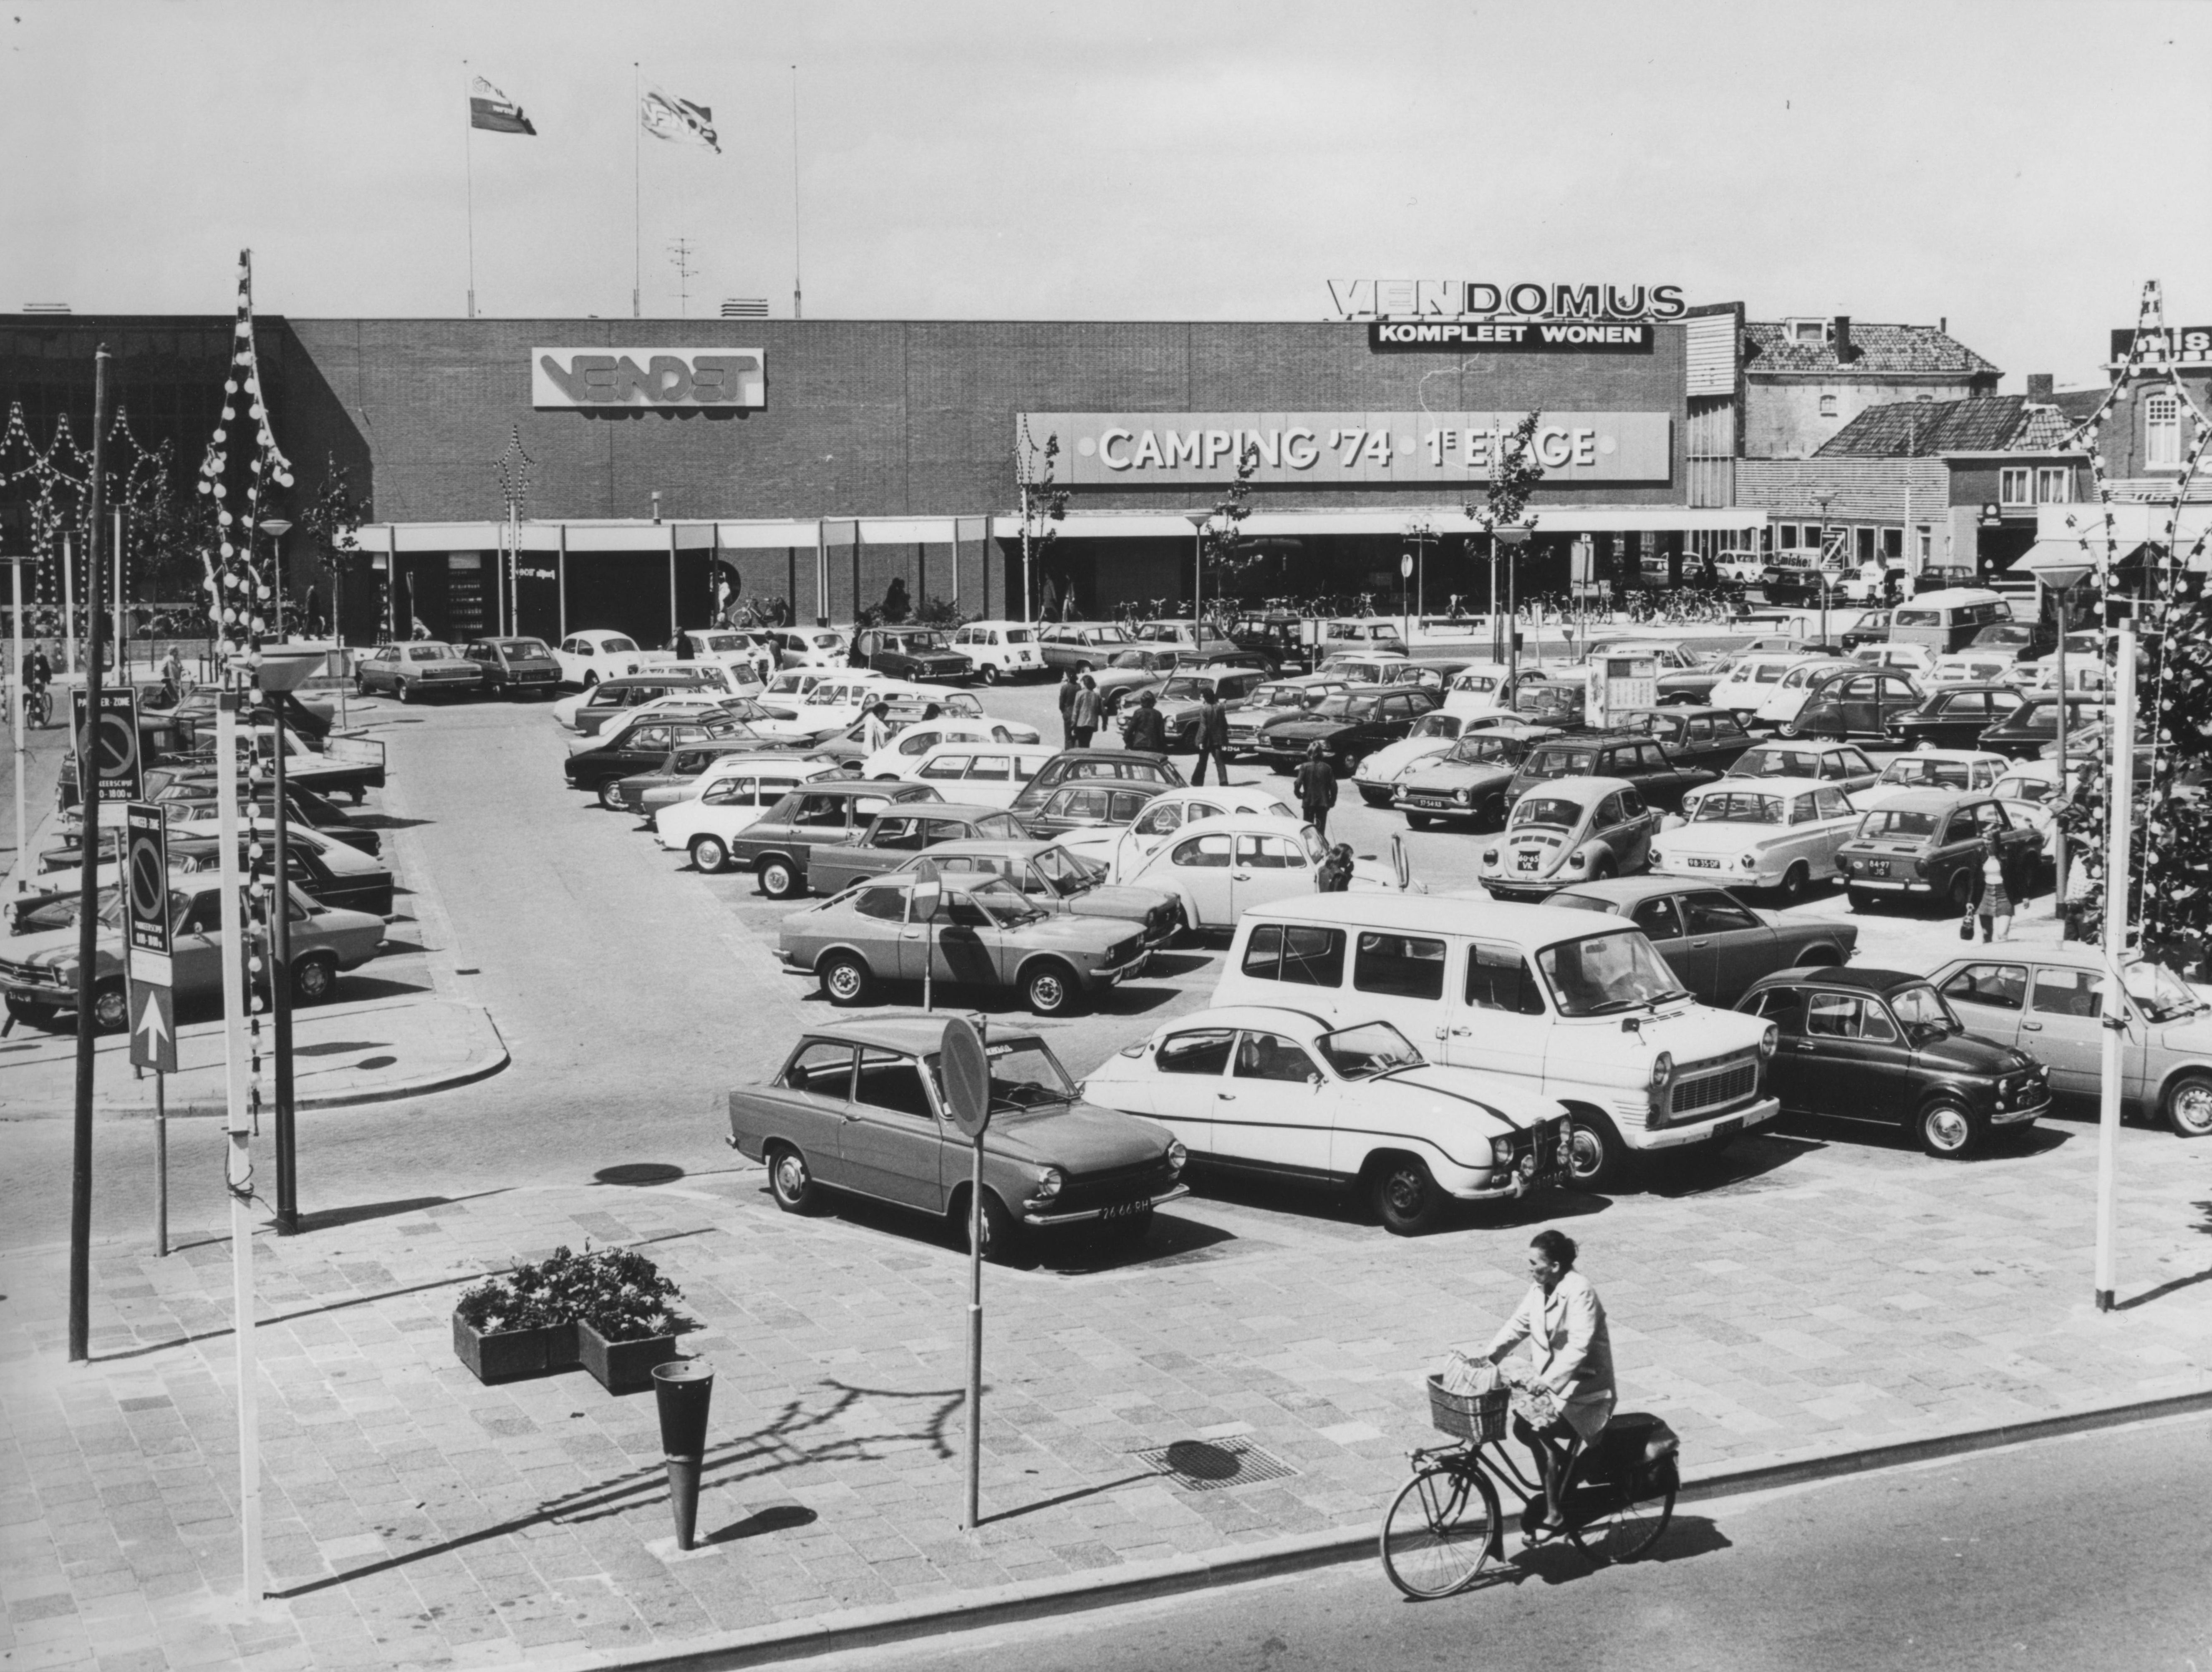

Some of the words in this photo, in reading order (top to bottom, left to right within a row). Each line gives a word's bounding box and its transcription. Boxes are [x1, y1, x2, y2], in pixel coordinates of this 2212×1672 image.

[1327, 279, 1688, 320] VENDOMUS
[1378, 324, 1528, 342] KOMPLEET
[1540, 325, 1643, 344] WONEN
[540, 355, 759, 402] VENDET
[1099, 426, 1319, 469] CAMPING
[1329, 428, 1392, 467] '74
[1465, 426, 1595, 466] ETAGE
